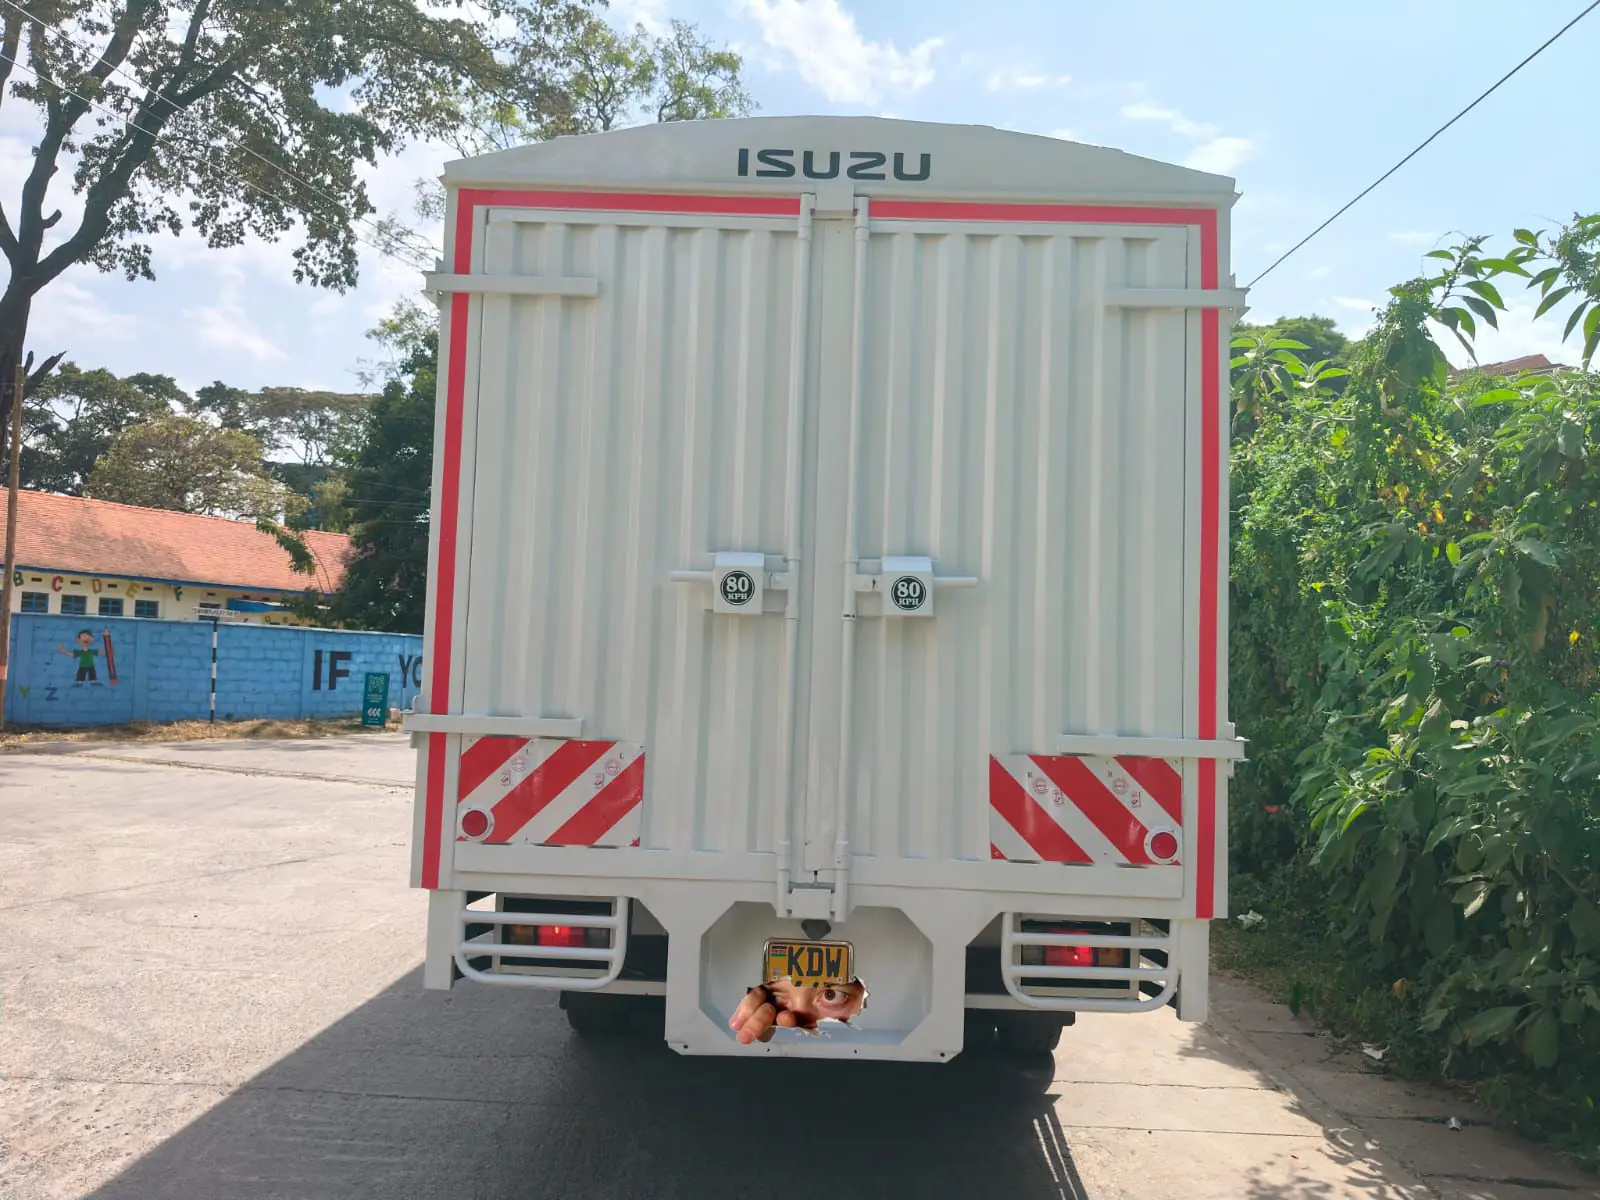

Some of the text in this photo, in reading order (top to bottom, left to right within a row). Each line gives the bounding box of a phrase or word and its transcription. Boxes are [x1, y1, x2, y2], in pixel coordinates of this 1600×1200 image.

[737, 148, 931, 181] ISUZU
[13, 571, 183, 601] B C D E F
[727, 576, 749, 592] 80
[897, 581, 920, 598] 80
[313, 649, 352, 690] IF
[45, 687, 58, 701] Z
[787, 946, 841, 977] KDW
